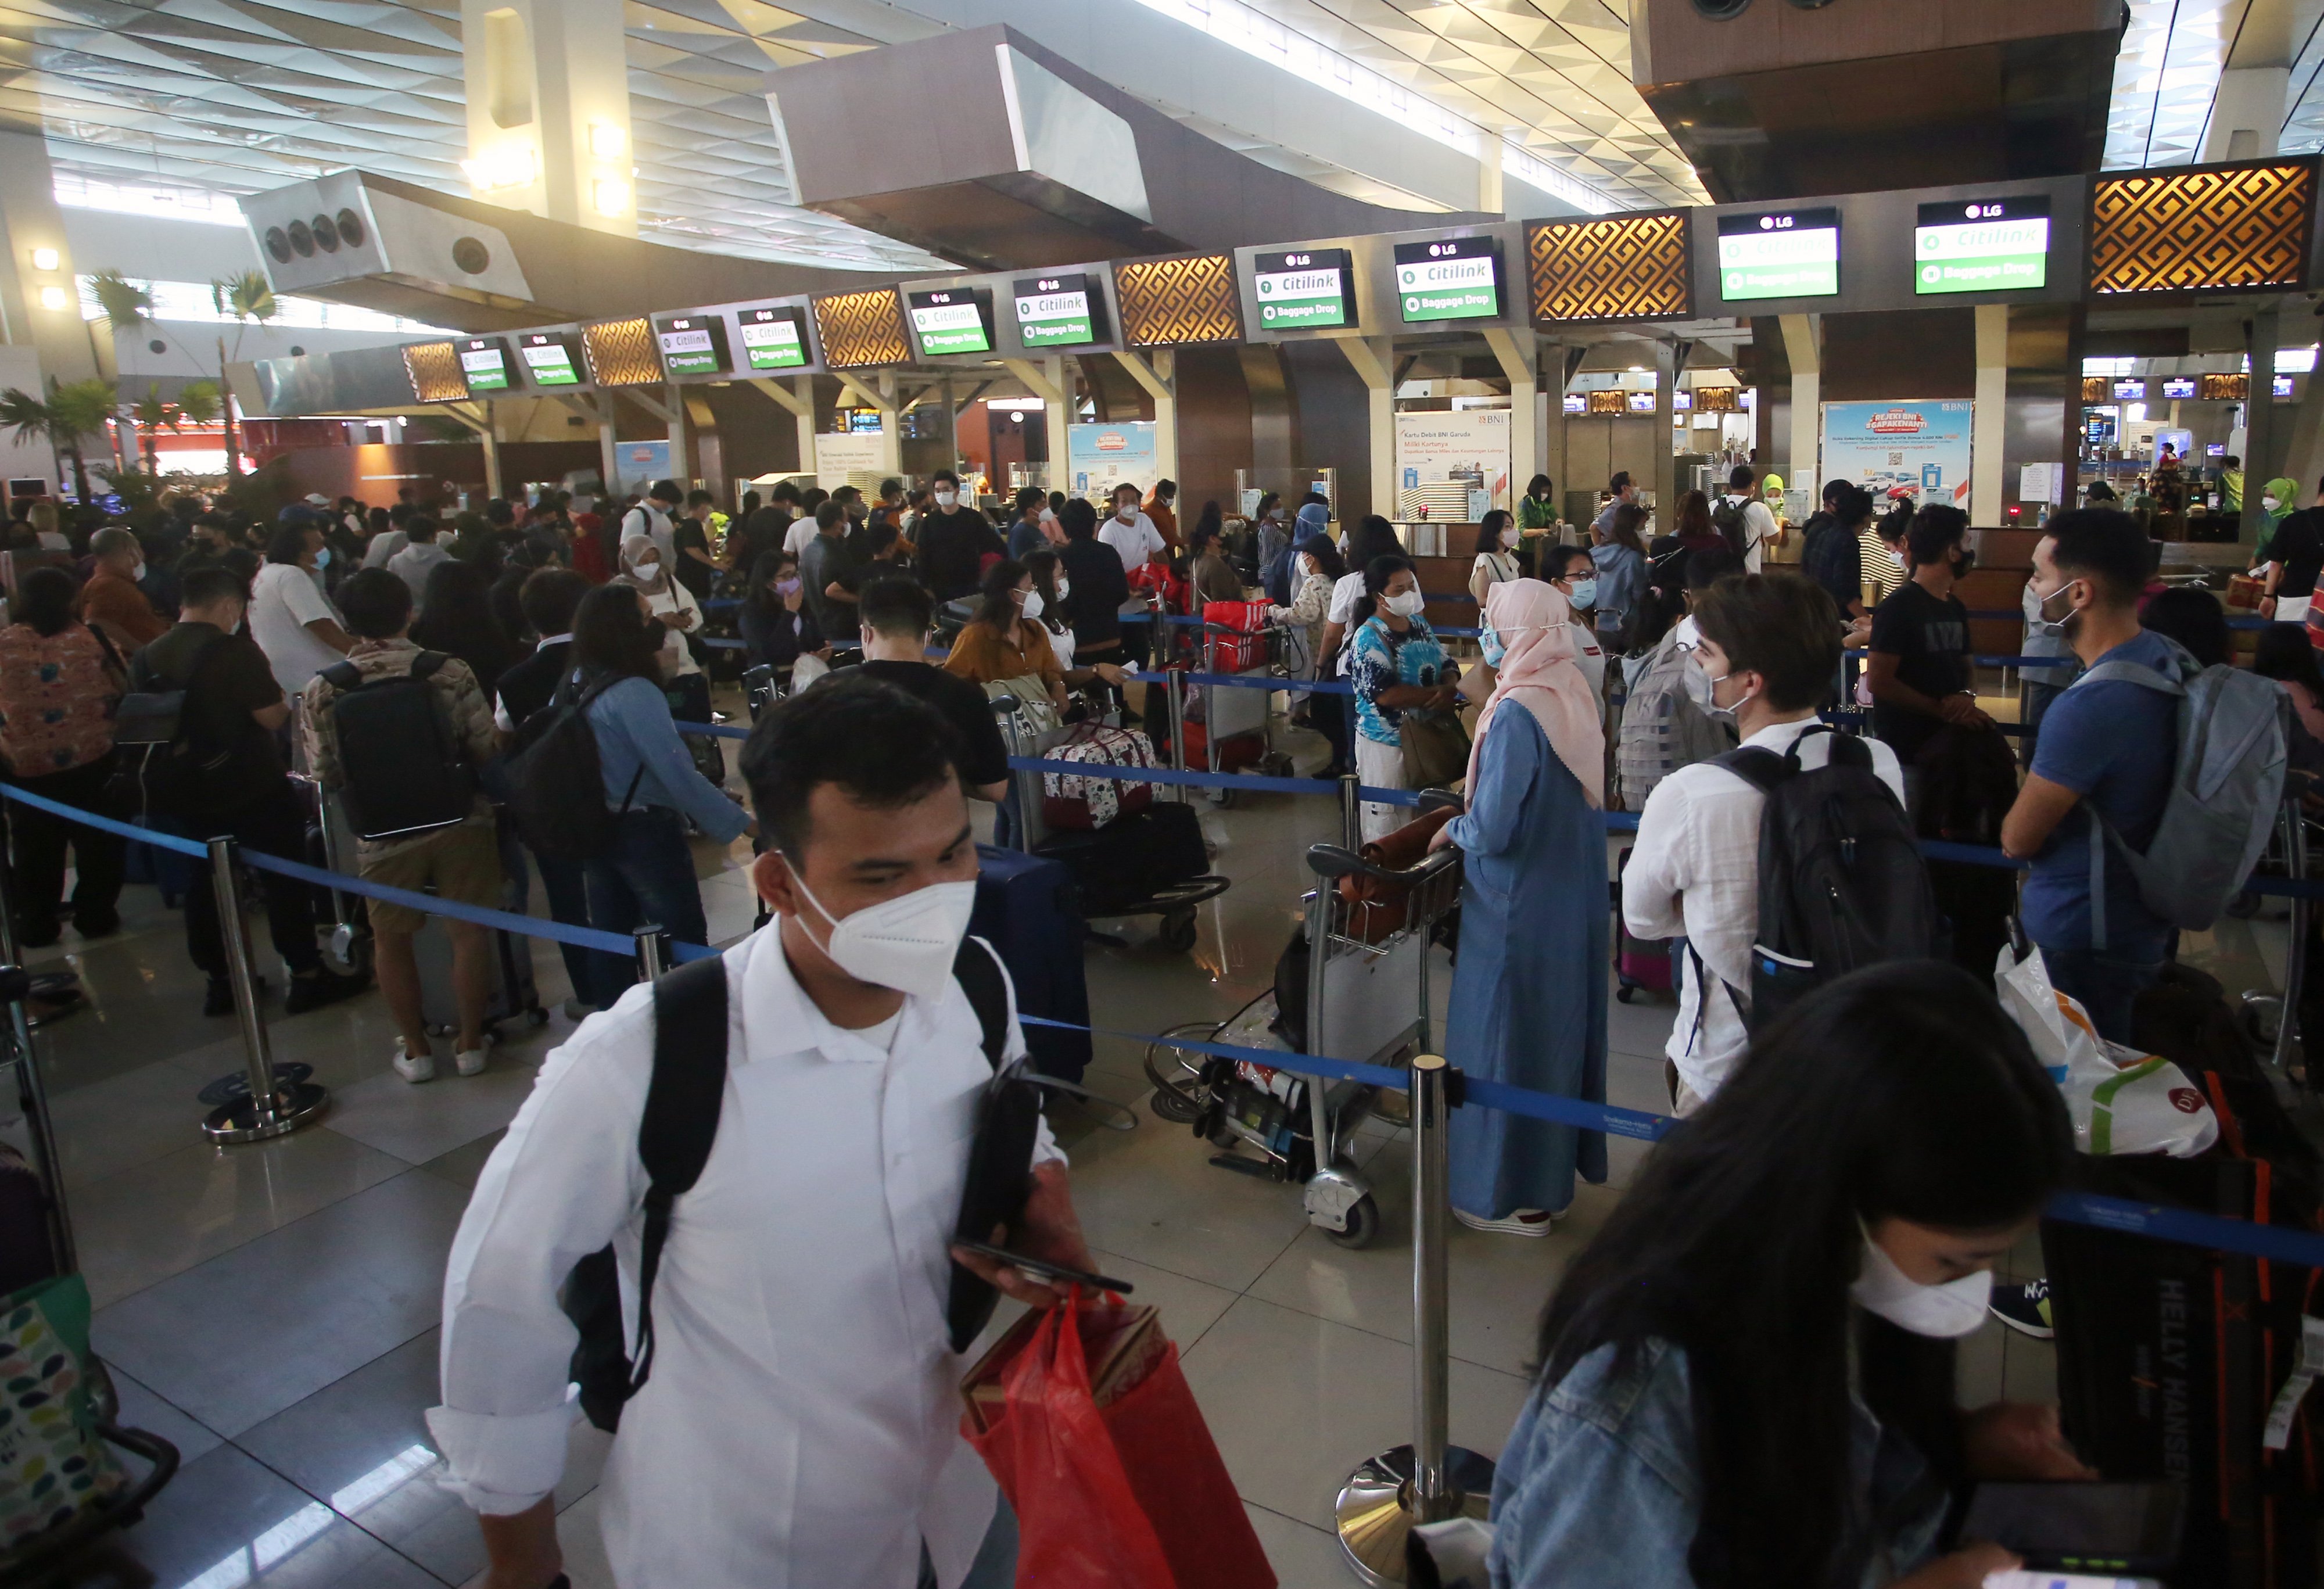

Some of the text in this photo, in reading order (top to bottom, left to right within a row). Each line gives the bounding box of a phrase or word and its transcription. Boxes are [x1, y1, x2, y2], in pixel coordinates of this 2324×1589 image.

[1983, 205, 2002, 217] LG
[1776, 217, 1793, 228] LG
[1958, 228, 2036, 246] Citilink
[1442, 244, 1457, 255] LG
[1297, 255, 1311, 266] LG
[1428, 263, 1486, 280] Citilink
[1944, 263, 2036, 279] Baggage Drop
[1048, 280, 1059, 289] LG
[1283, 274, 1334, 290] Citilink
[939, 294, 950, 303] LG
[1039, 297, 1081, 311] Citilink
[1422, 295, 1489, 309] Baggage Drop
[934, 309, 973, 322] Citilink
[1278, 304, 1336, 317] Baggage Drop
[759, 327, 792, 338] Citilink
[1035, 324, 1085, 336] Baggage Drop
[676, 334, 706, 346] Citilink
[934, 333, 980, 345] Baggage Drop
[1487, 415, 1504, 424] BNI
[2160, 1279, 2186, 1369] HELLY
